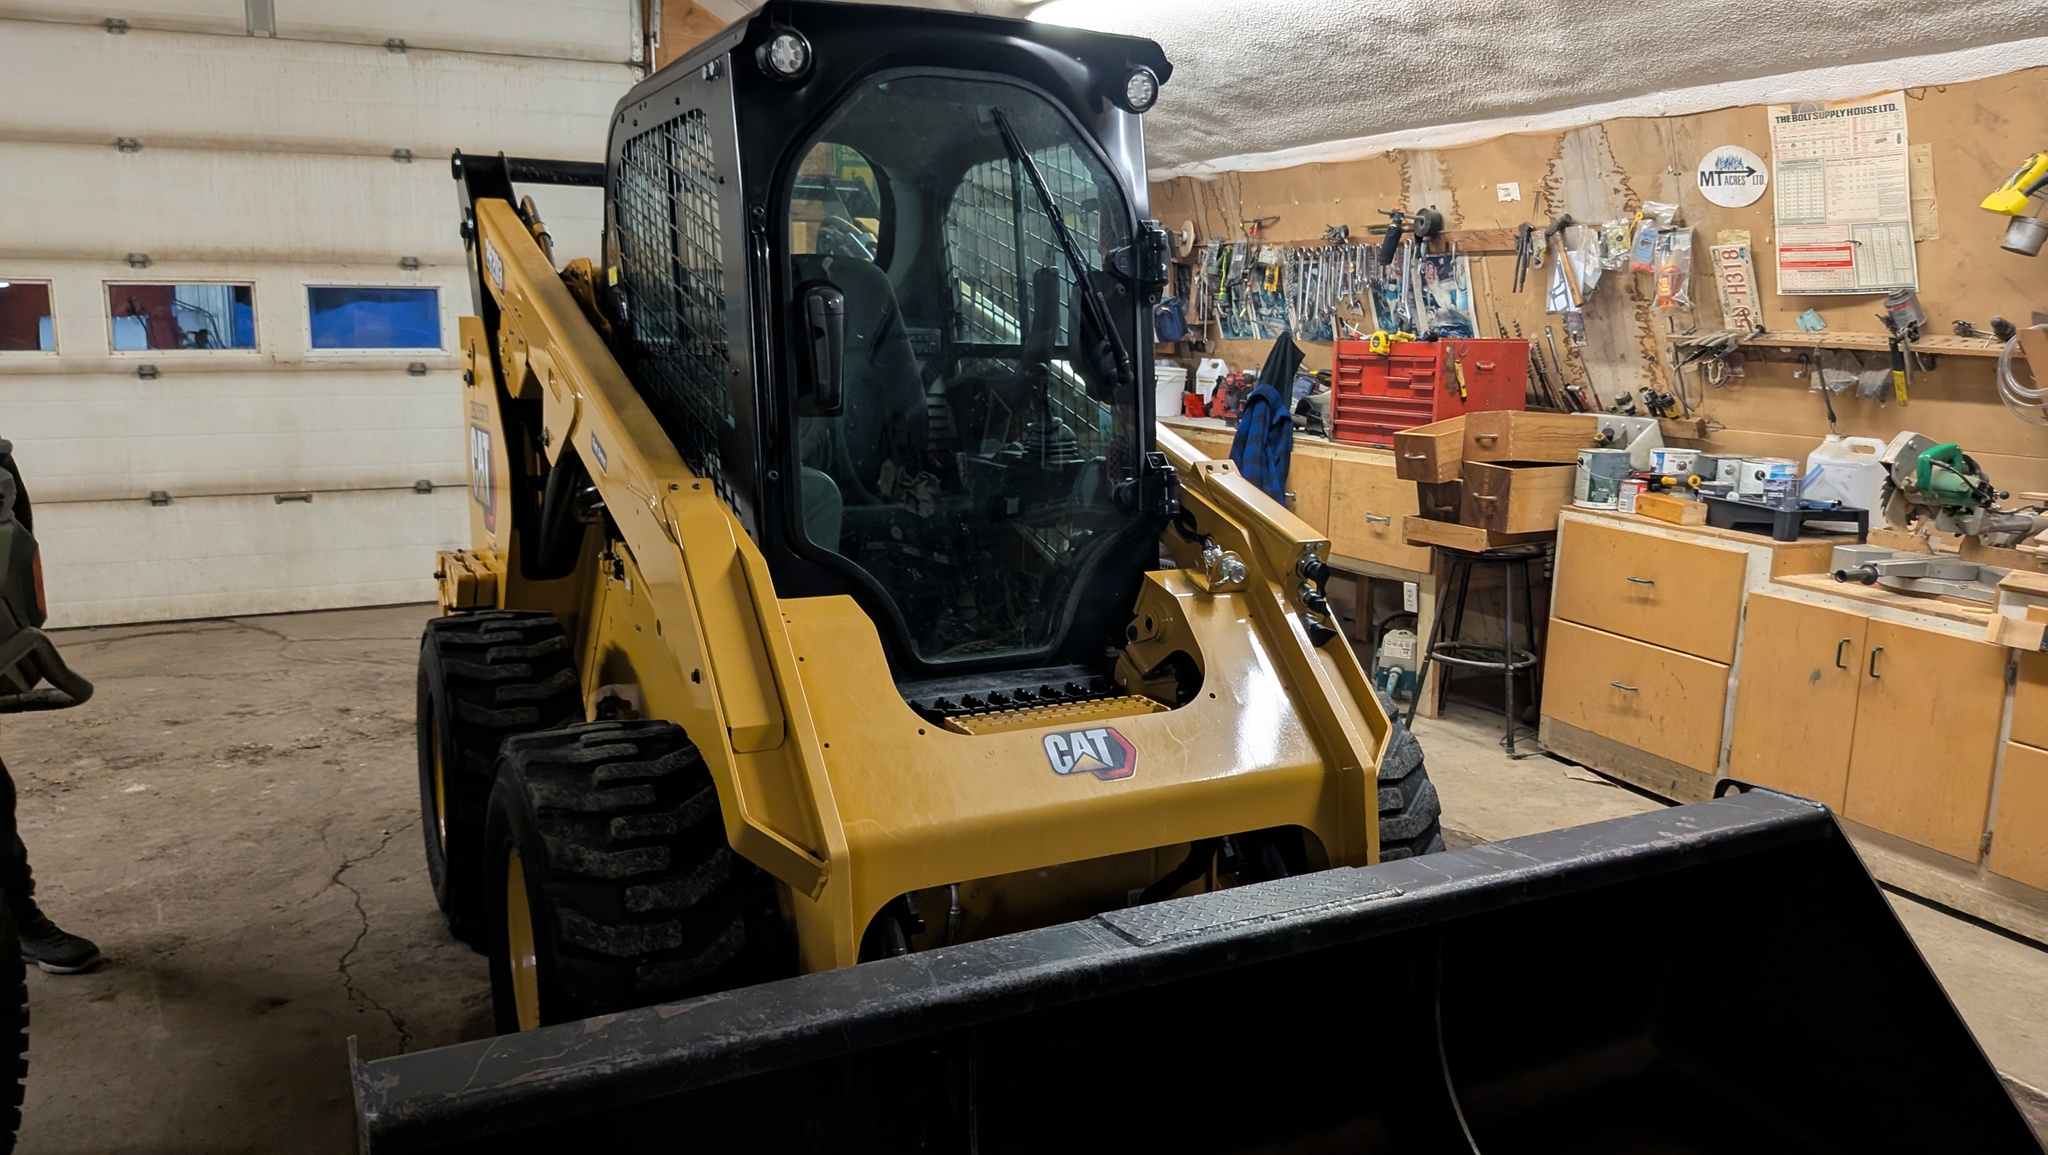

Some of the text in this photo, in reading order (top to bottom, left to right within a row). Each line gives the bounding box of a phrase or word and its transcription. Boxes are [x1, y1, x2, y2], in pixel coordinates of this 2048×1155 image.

[1775, 103, 1898, 124] THE BOLT SUPPLY HOUSE LTD.
[1700, 171, 1722, 187] MT
[1724, 175, 1746, 186] ACRES
[471, 427, 490, 506] CAT
[1044, 728, 1114, 774] CAT
